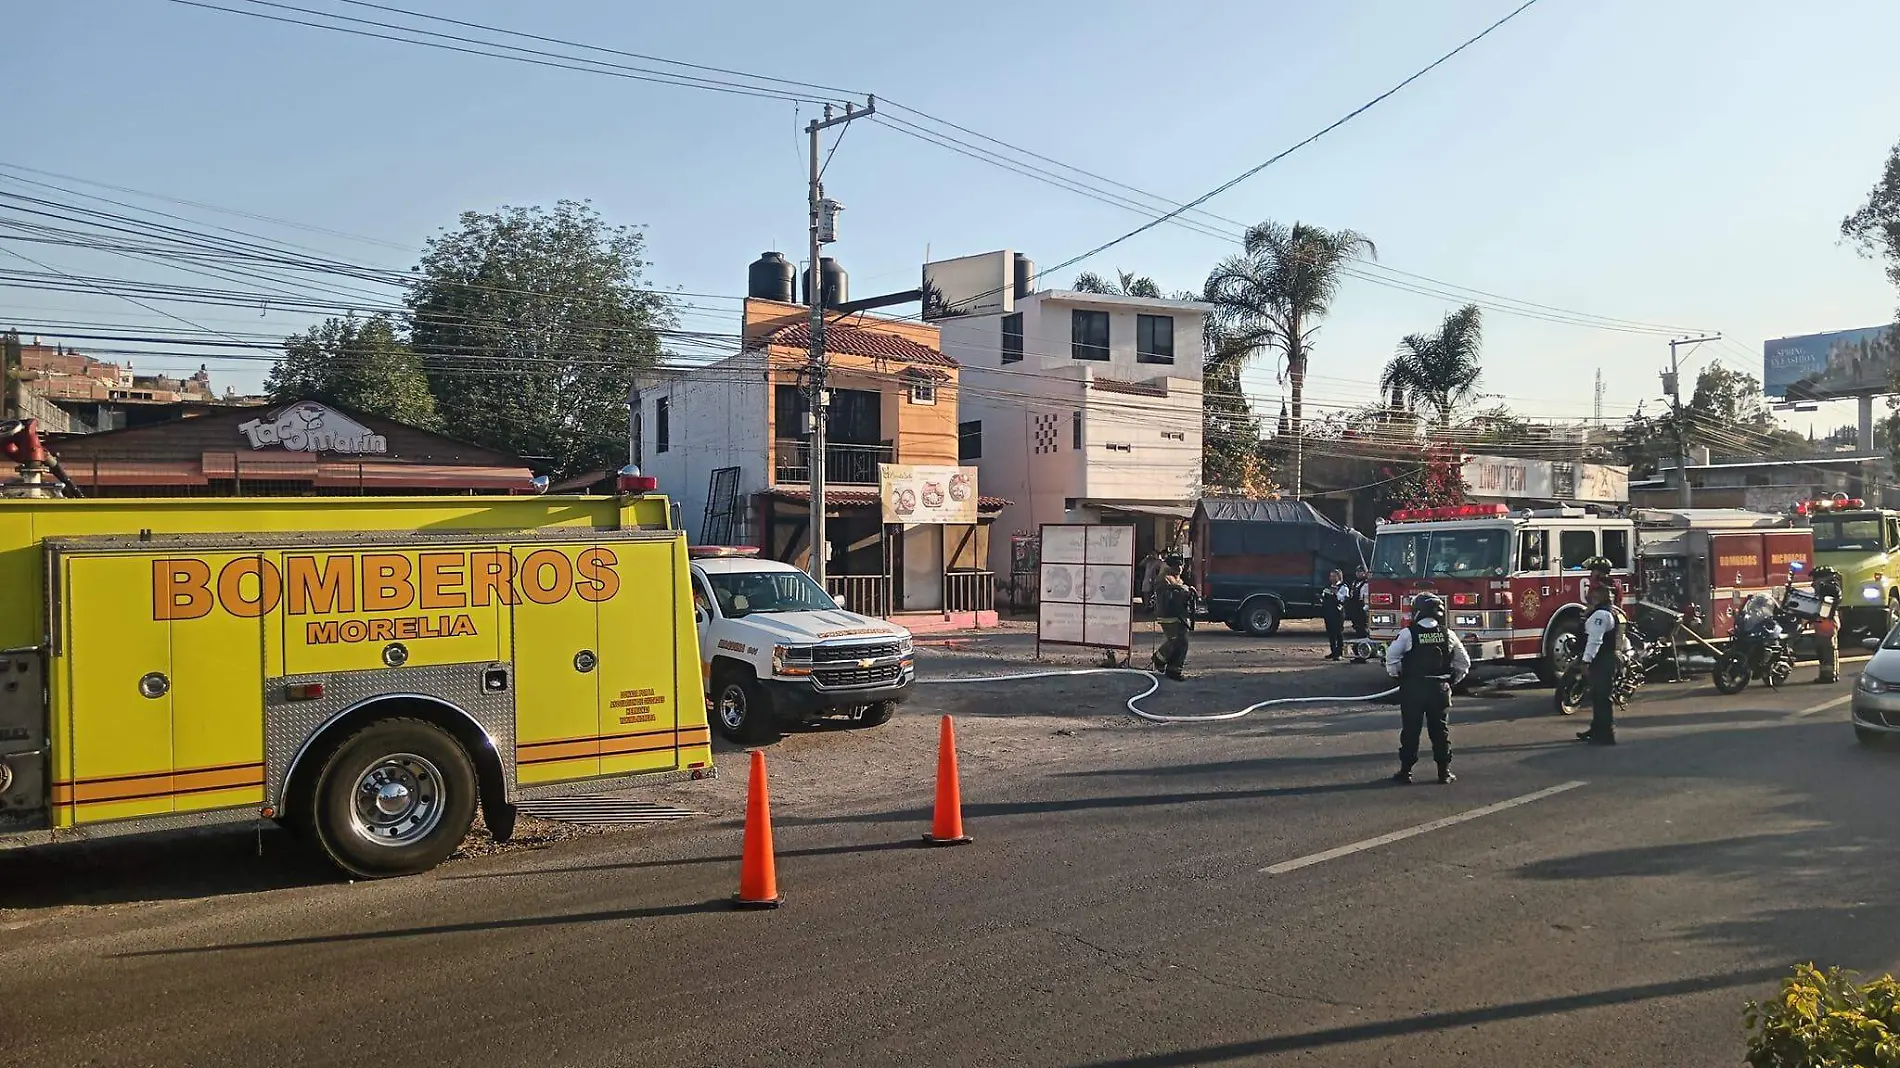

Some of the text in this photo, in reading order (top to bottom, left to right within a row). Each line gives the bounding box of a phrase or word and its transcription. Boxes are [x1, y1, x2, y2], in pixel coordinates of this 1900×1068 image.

[1719, 555, 1758, 567] BOMBEROS
[152, 548, 620, 621] BOMBEROS
[306, 615, 477, 645] MORELIA
